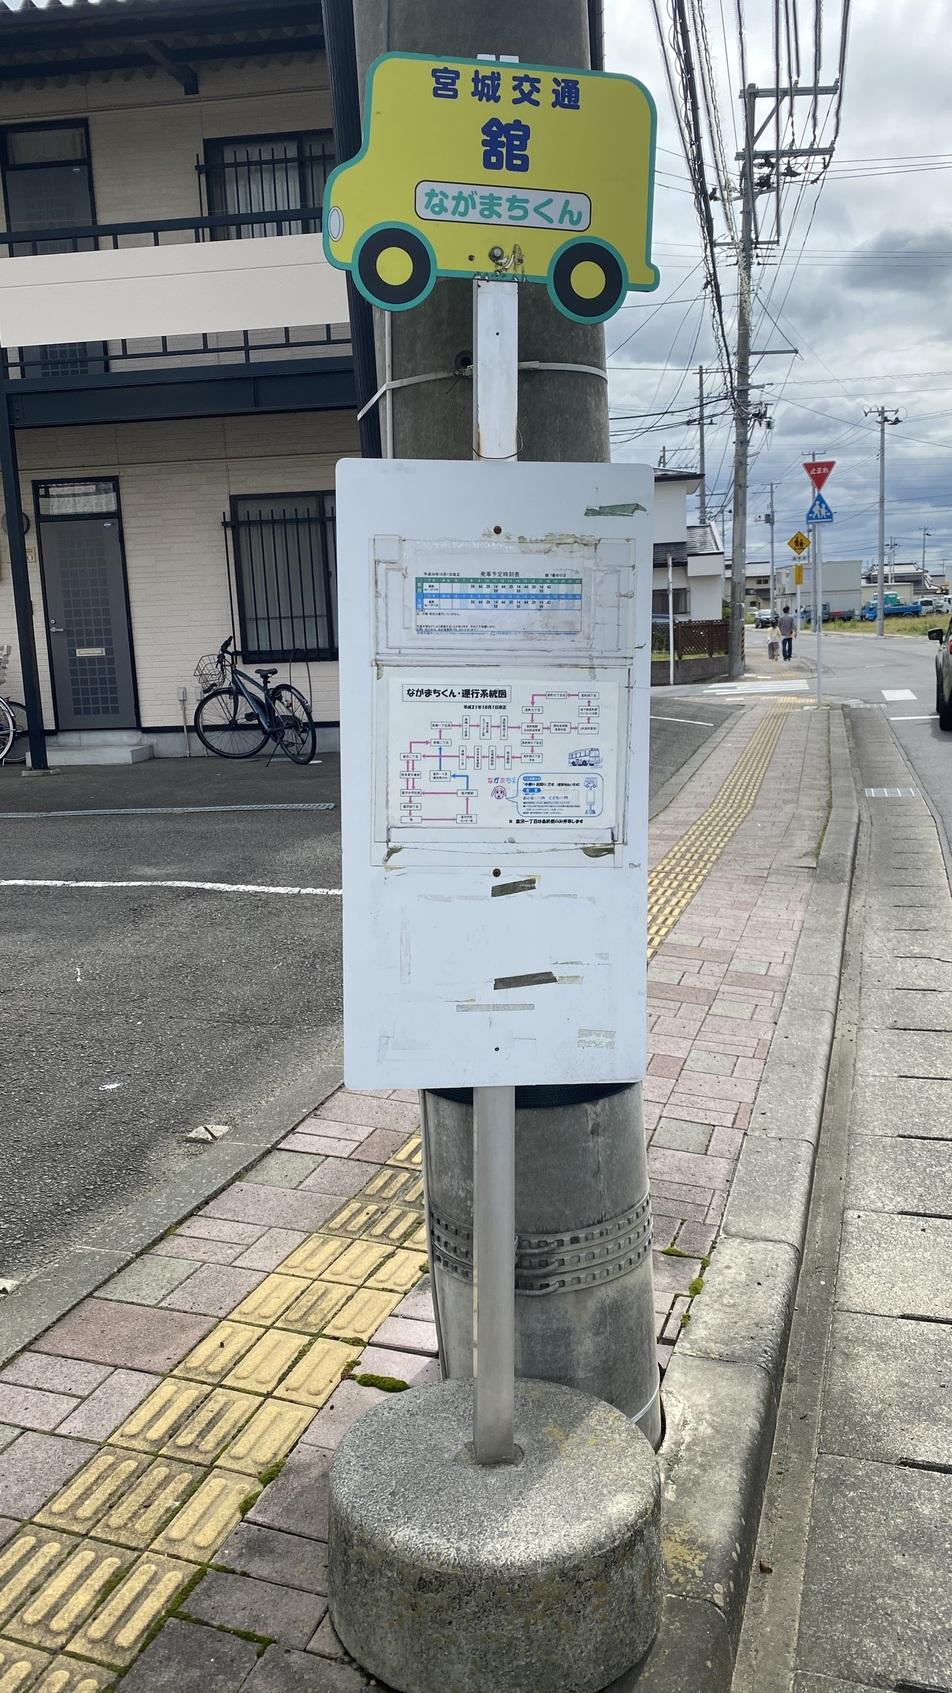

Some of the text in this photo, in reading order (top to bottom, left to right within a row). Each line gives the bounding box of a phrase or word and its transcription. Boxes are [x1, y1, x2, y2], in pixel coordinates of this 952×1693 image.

[431, 67, 580, 110] 宮城交通
[424, 188, 583, 226] ながまちくん
[407, 688, 507, 699] ながまちくん・運行系統図
